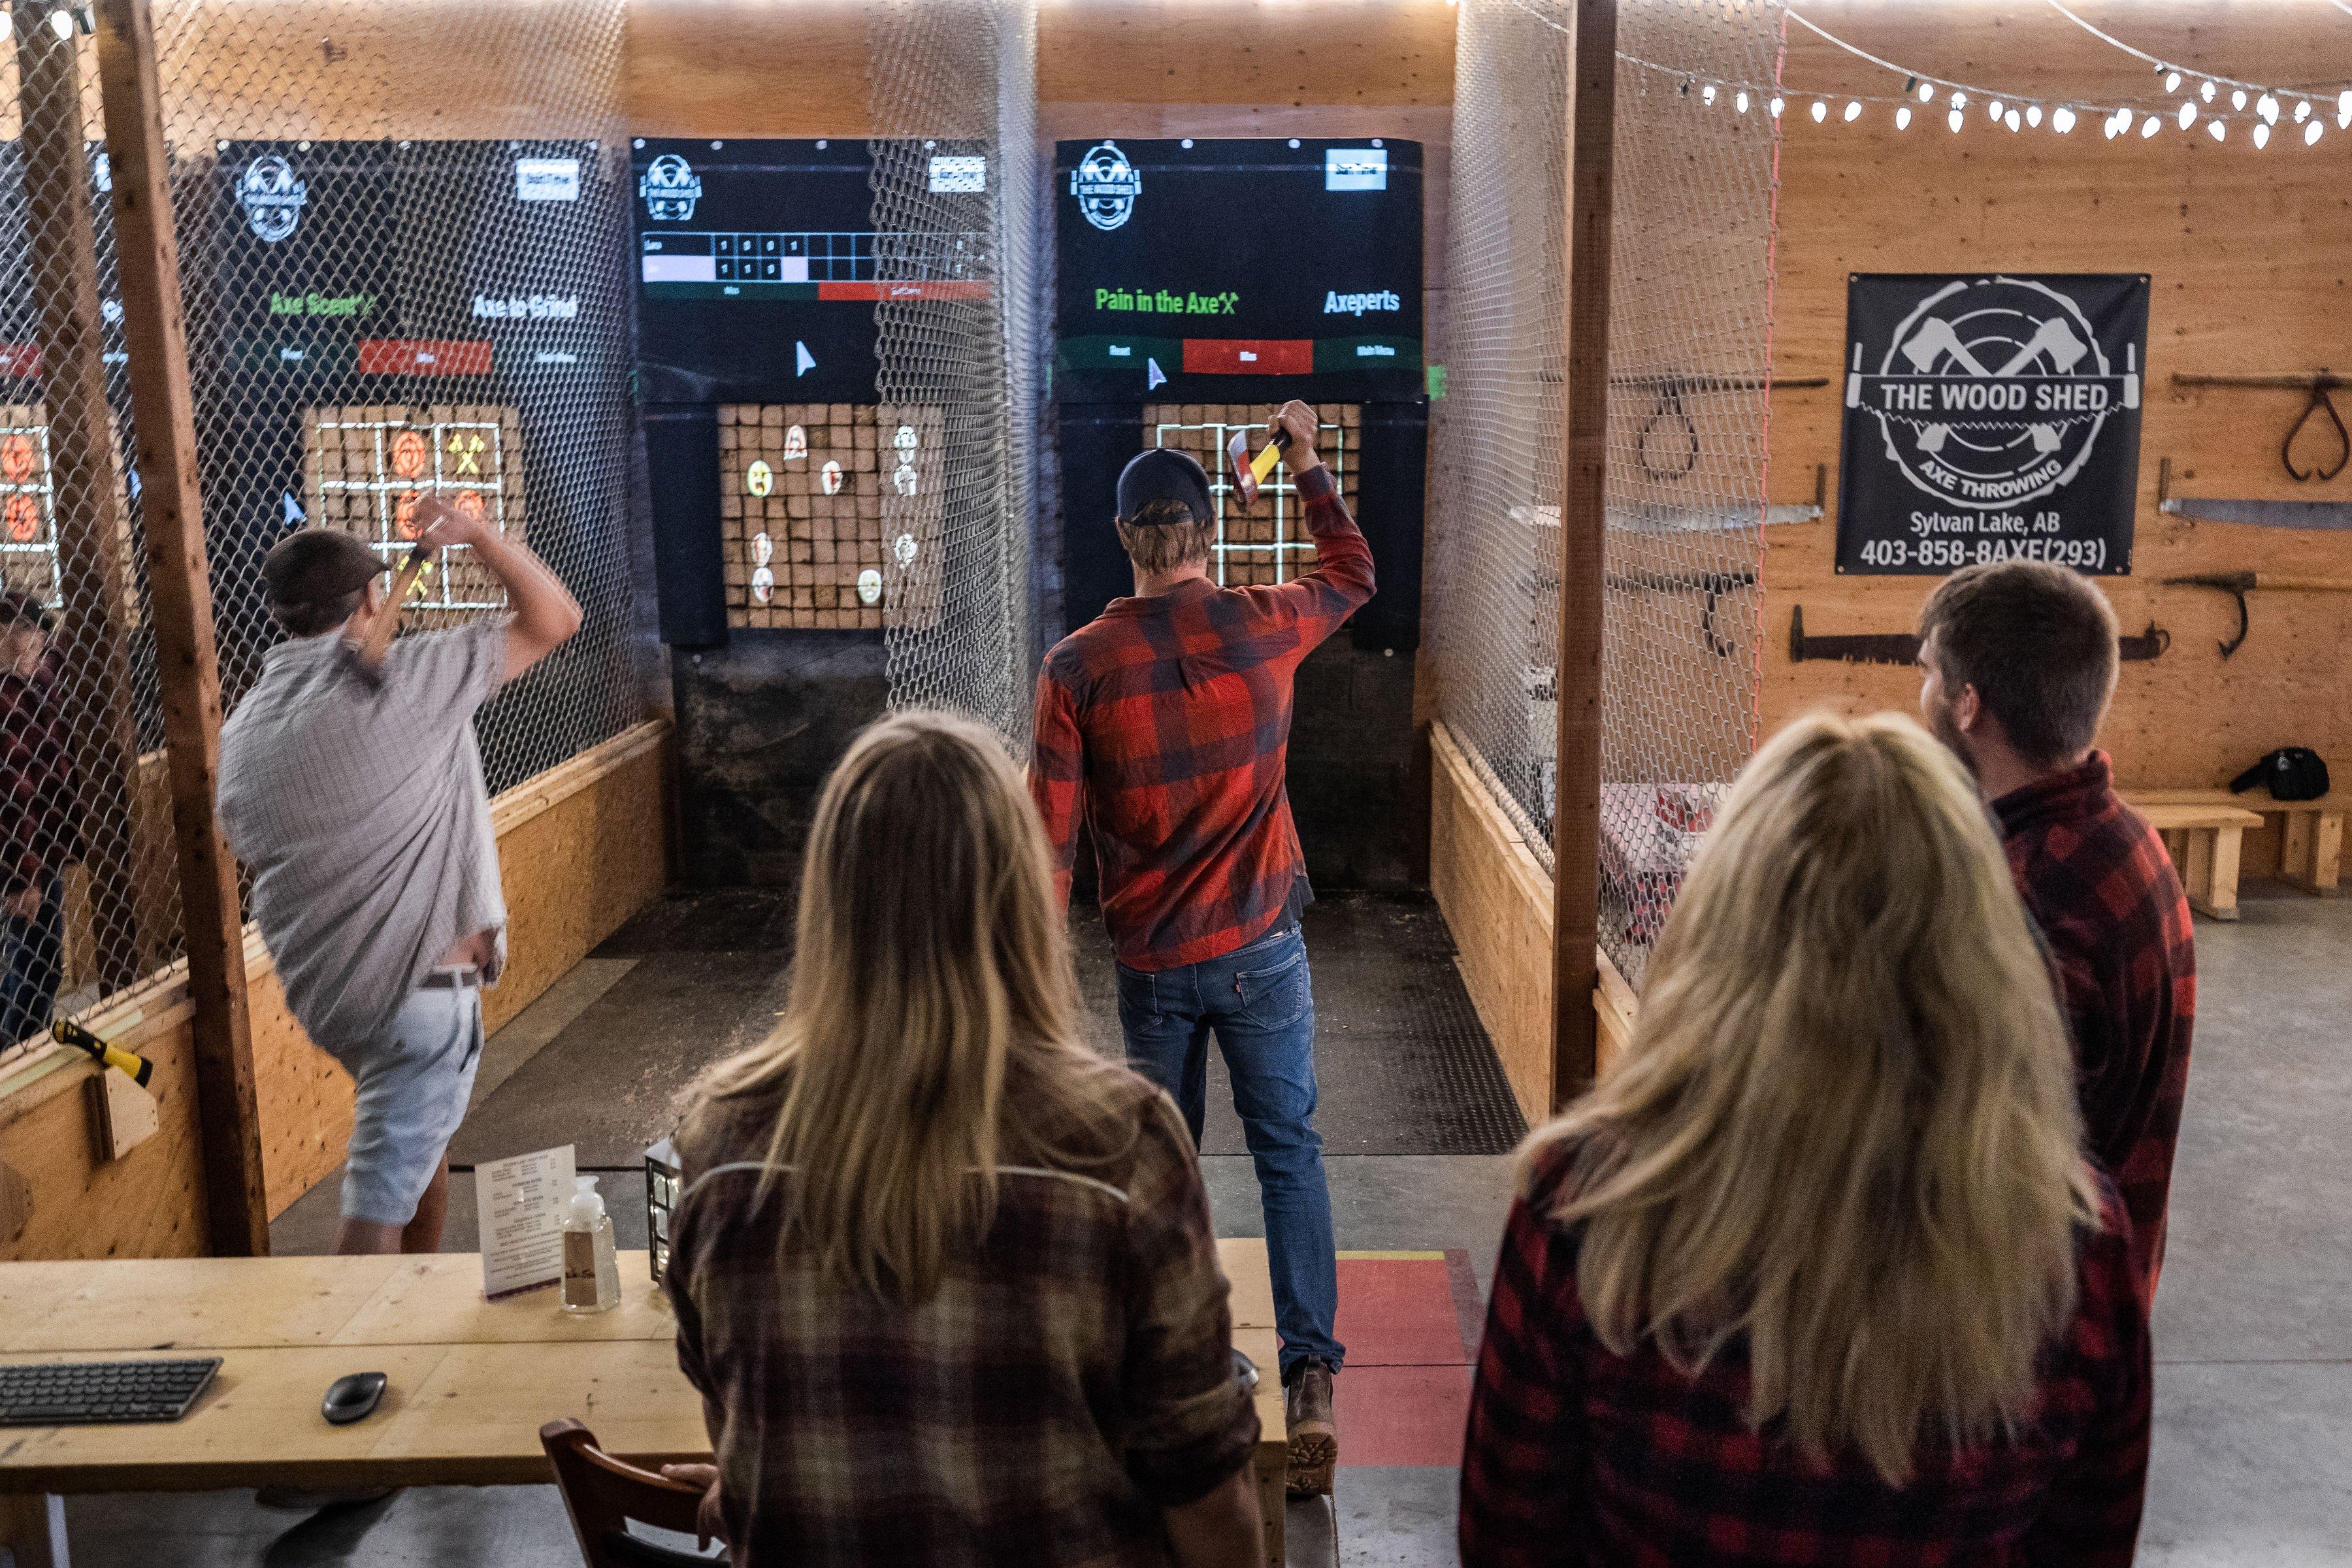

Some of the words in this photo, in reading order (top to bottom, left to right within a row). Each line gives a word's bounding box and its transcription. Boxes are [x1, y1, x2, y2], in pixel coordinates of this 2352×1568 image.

[472, 294, 506, 318] Axe
[1095, 287, 1134, 310] Pain
[1136, 289, 1152, 312] in
[1155, 289, 1183, 313] the
[1186, 291, 1219, 314] Axe
[1324, 289, 1399, 317] Axeperts
[1880, 384, 1933, 410] THE
[1940, 384, 2027, 411] WOOD
[2034, 384, 2108, 411] SHED
[1918, 460, 1958, 490] AXE
[1961, 459, 2063, 498] THROWING
[1910, 511, 1974, 537] Sylvan
[1978, 512, 2029, 536] Lake,
[2033, 512, 2060, 532] AB
[1860, 537, 2106, 570] 403-858-8AXE(293)
